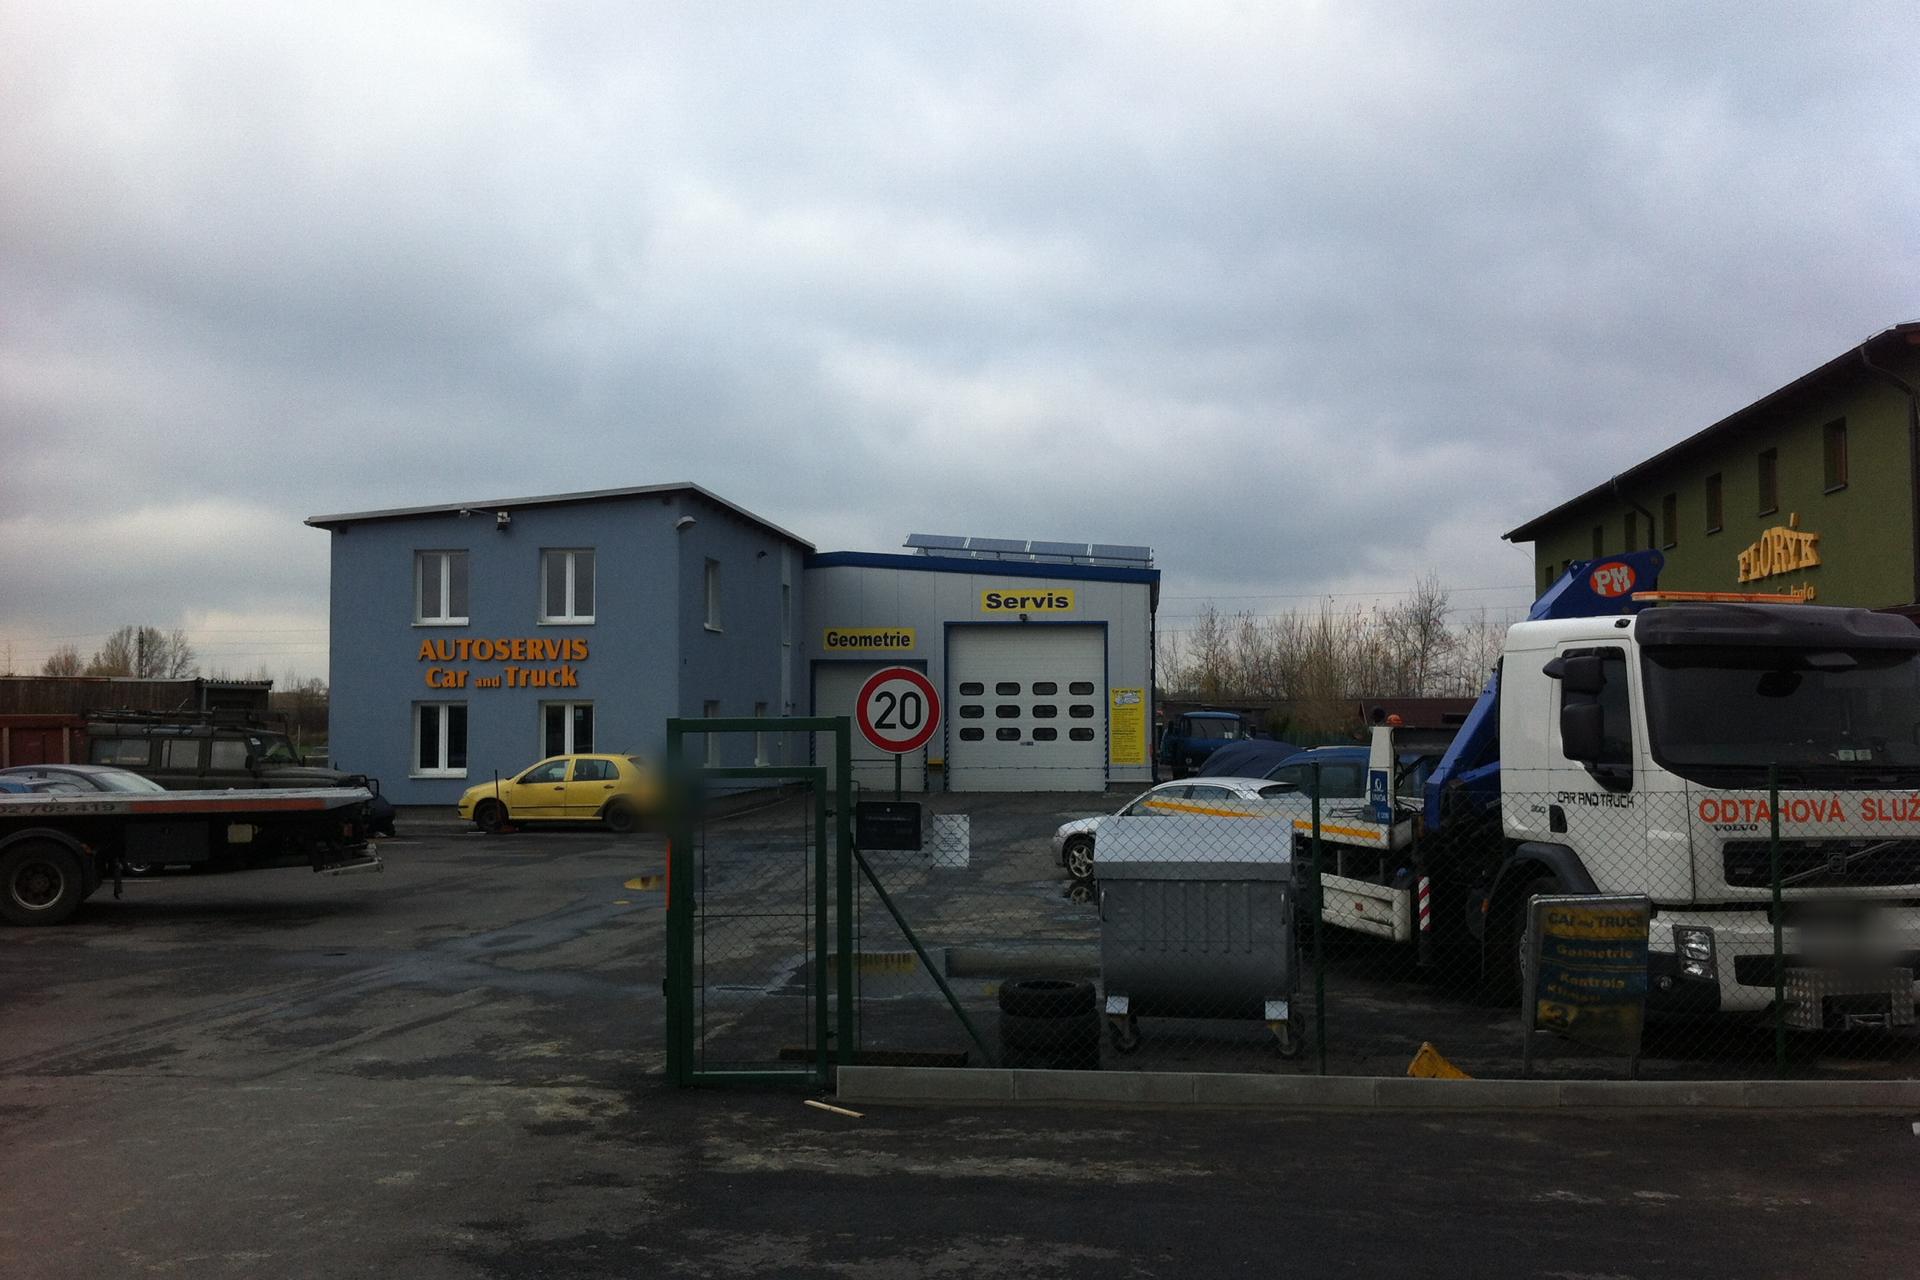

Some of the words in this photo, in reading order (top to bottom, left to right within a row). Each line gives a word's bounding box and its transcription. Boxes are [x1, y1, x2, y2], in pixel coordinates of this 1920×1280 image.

[1593, 565, 1632, 595] PM
[985, 593, 1069, 609] Servis
[418, 638, 589, 661] AUTOSERVIS
[827, 631, 910, 647] Geometrie
[425, 667, 469, 688] Car
[475, 675, 501, 688] and
[504, 664, 579, 688] Truck
[874, 691, 922, 730] 20
[1557, 791, 1576, 804] CAR
[1578, 792, 1599, 806] AND
[1601, 793, 1635, 809] TRUCK
[1698, 792, 1846, 823] ODTAHOVÁ
[1713, 823, 1759, 832] VOLVO
